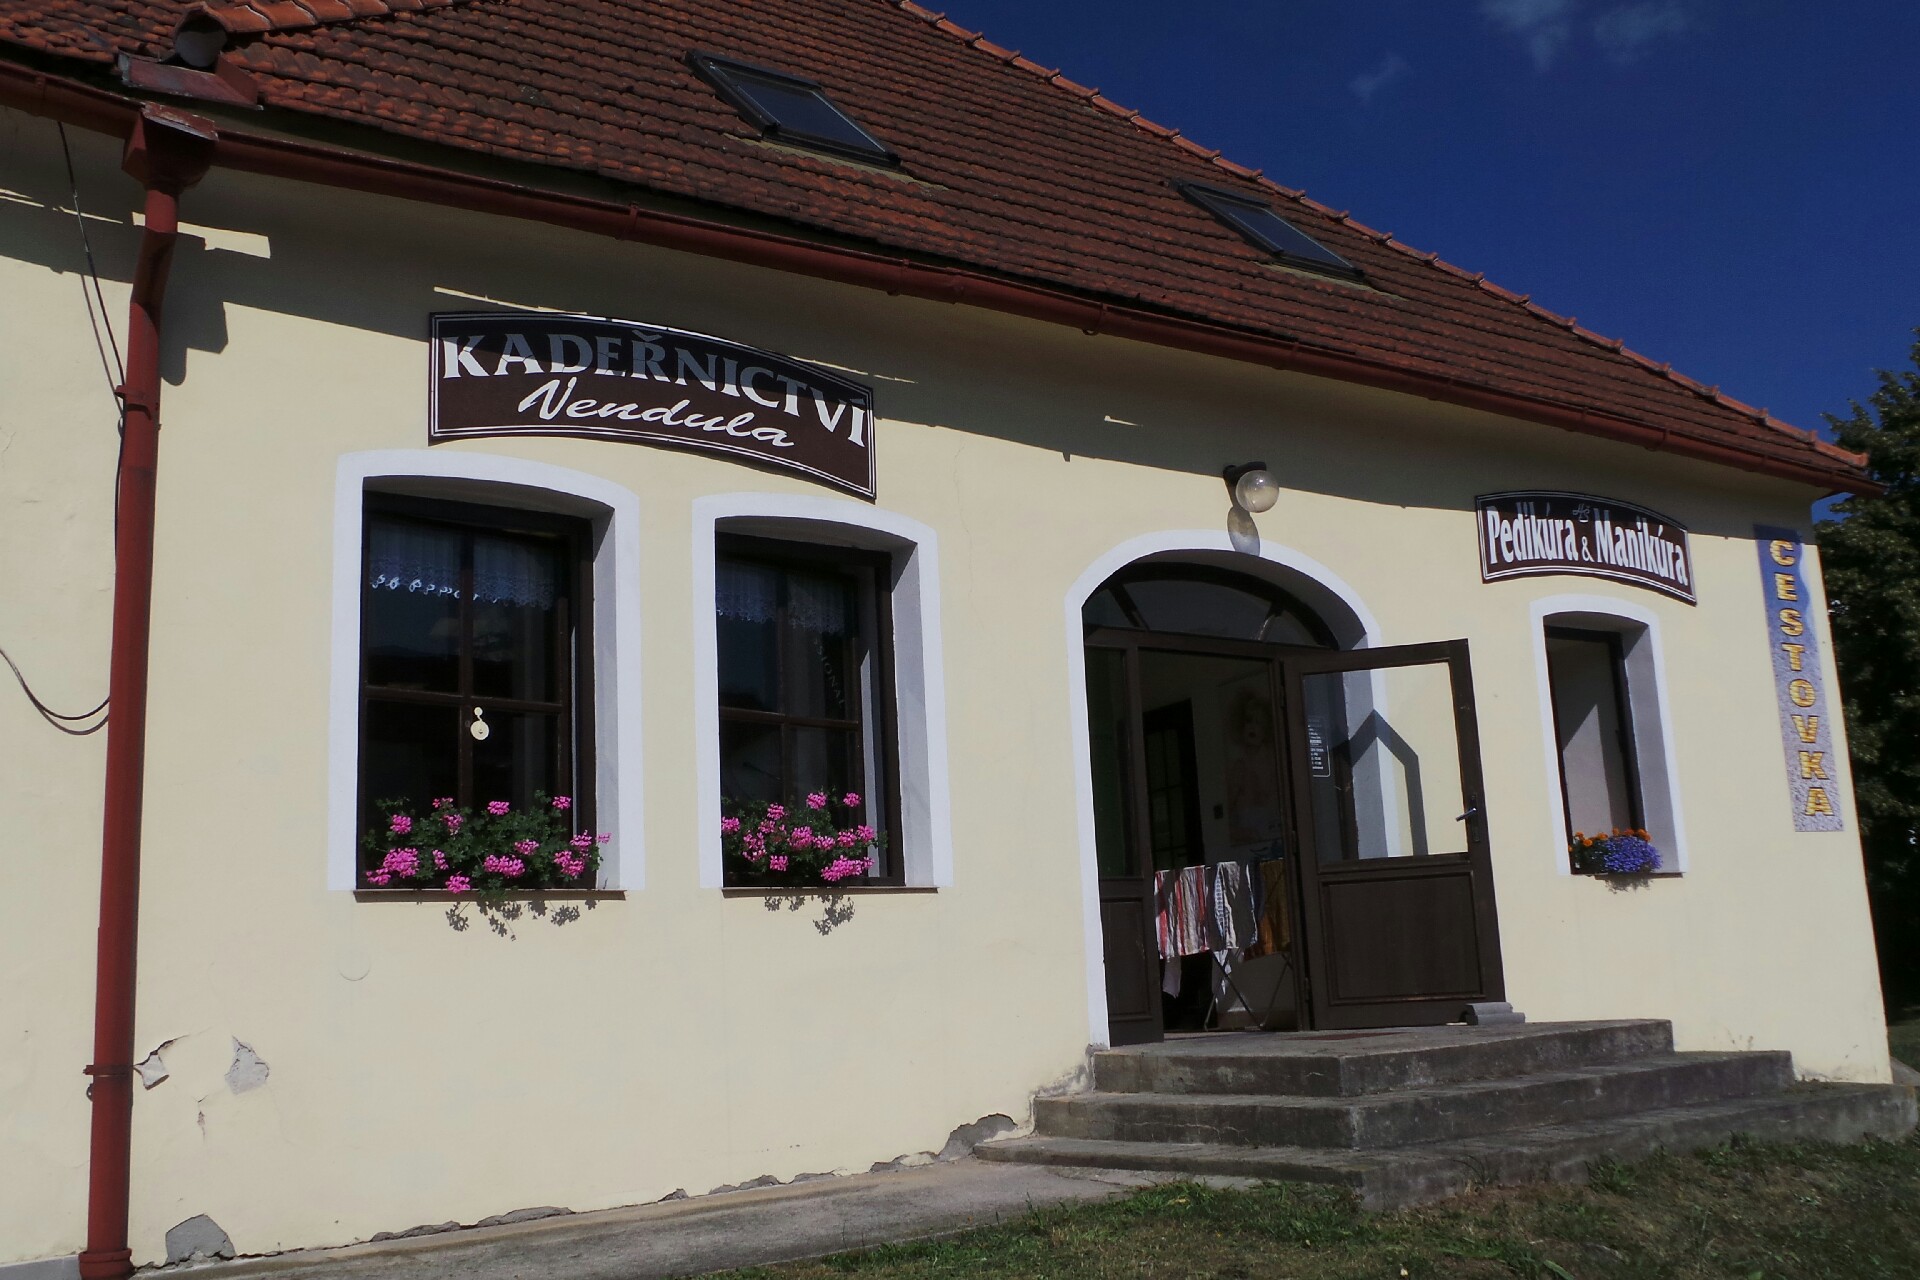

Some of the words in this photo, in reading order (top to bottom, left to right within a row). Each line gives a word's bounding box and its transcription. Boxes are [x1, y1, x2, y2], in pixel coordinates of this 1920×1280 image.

[441, 330, 866, 448] KADEŘNICTVÍ
[1486, 501, 1579, 564] Pedikúra
[1581, 536, 1594, 562] &
[1594, 508, 1688, 586] Manikúra
[1769, 539, 1833, 816] CESTOVKA
